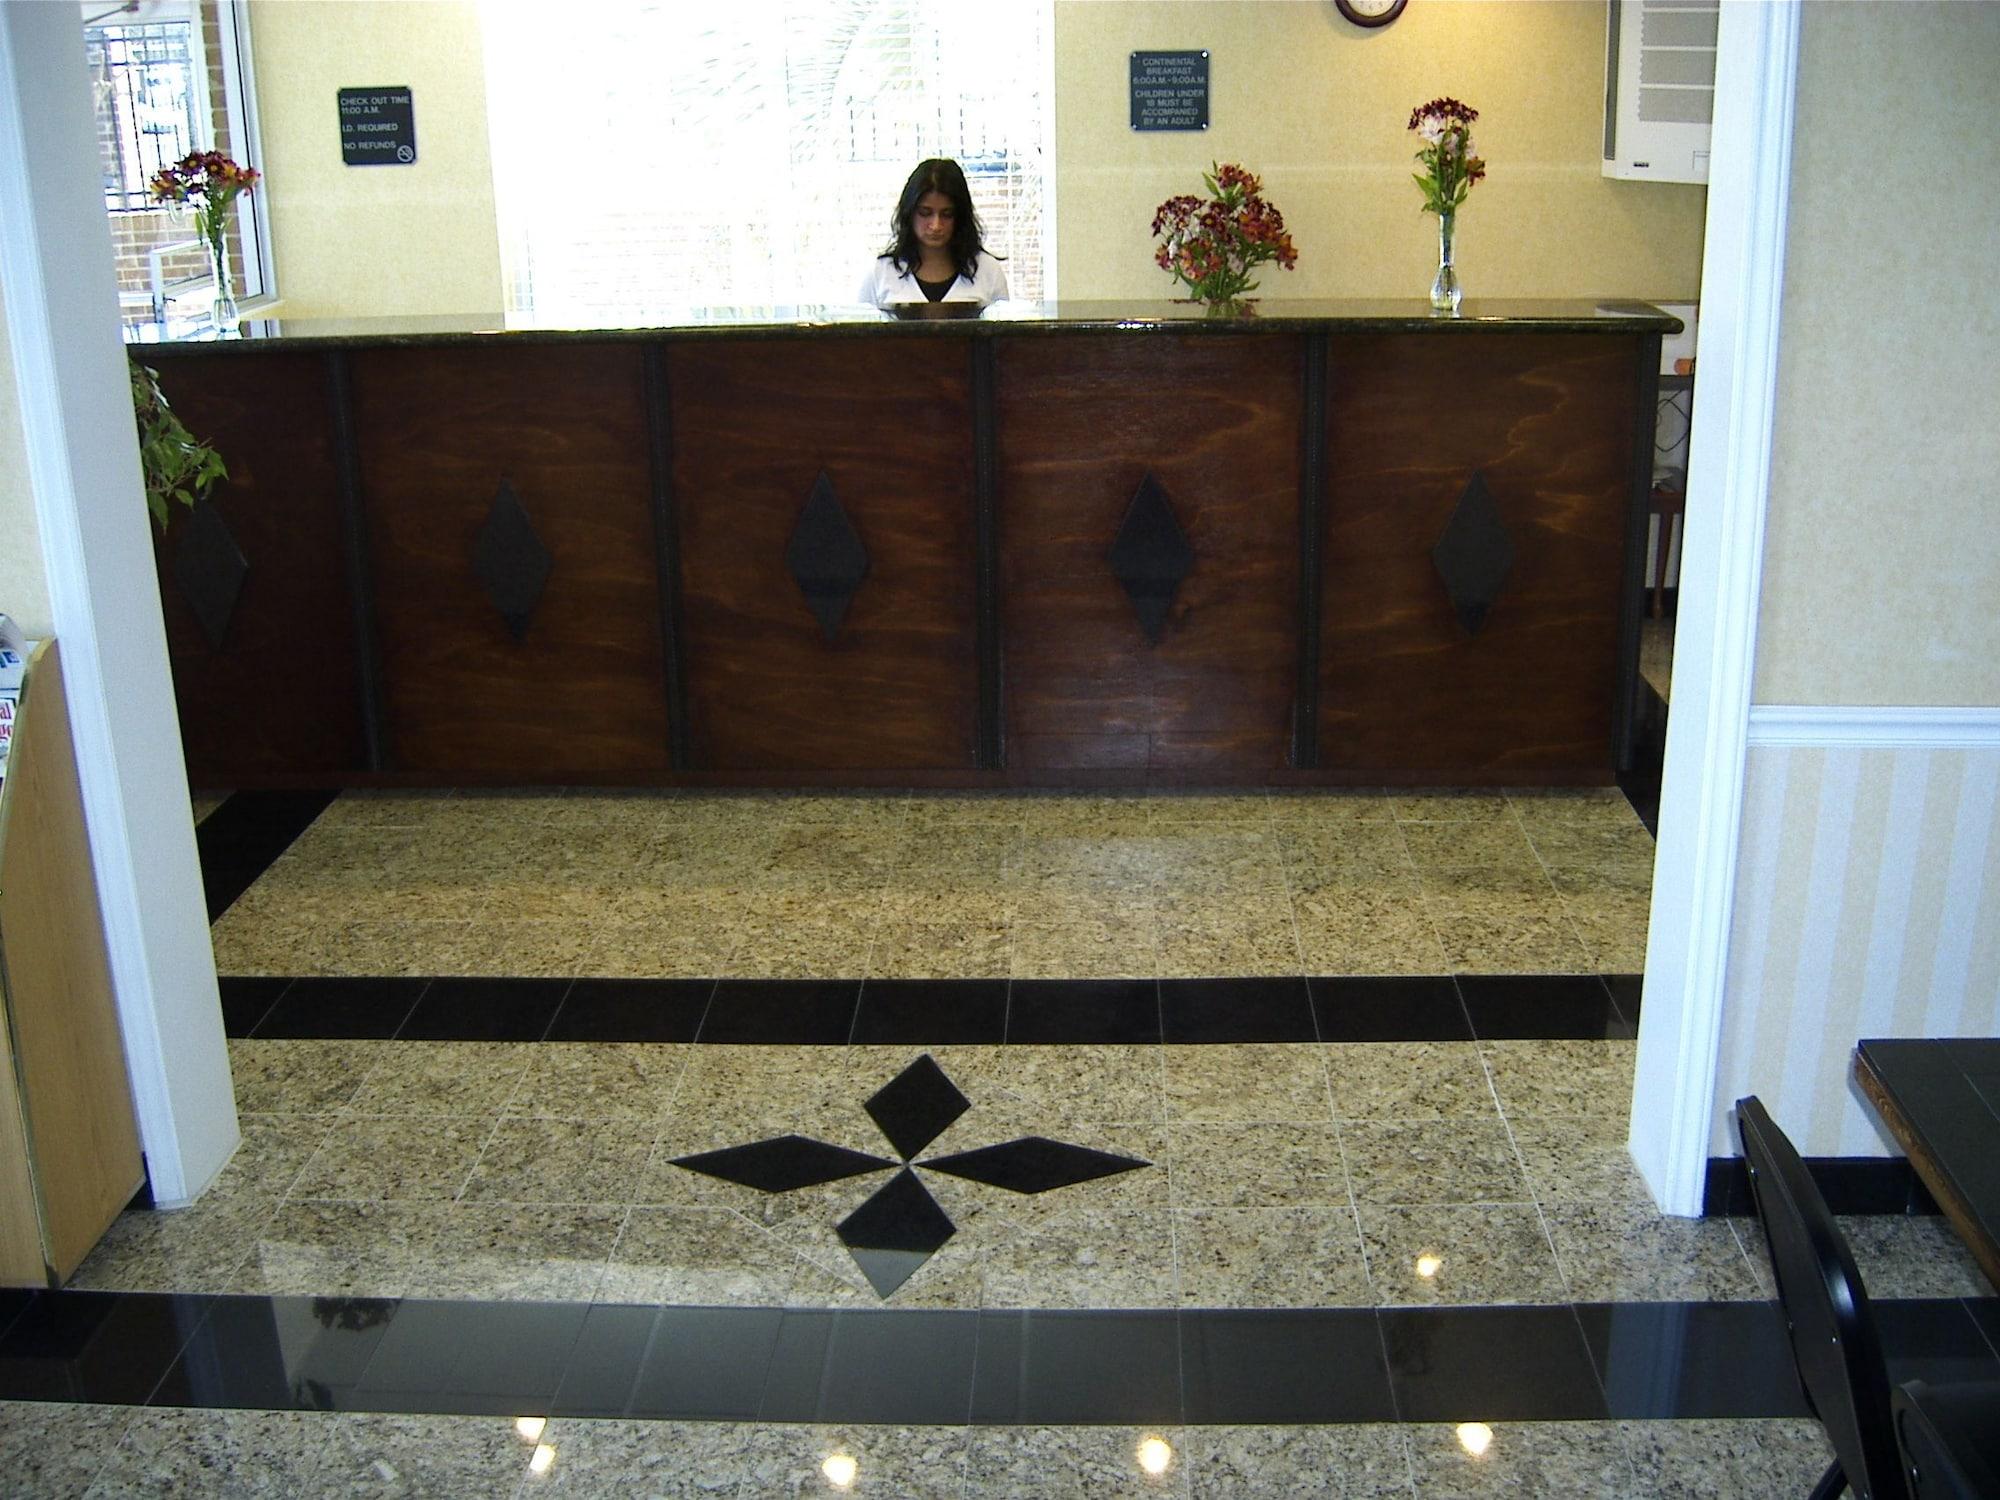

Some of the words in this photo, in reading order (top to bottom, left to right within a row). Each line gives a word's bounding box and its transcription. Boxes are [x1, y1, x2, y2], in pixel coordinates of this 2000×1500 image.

[1142, 58, 1196, 66] CONTINENTAL
[1146, 67, 1191, 75] BREAKFAST
[1135, 90, 1175, 98] CHILDREN
[1177, 89, 1205, 97] UNDER
[340, 97, 369, 105] CHECK
[371, 97, 388, 105] OUT
[391, 96, 410, 104] TIME
[1157, 99, 1179, 107] MUST
[1182, 98, 1193, 106] BE
[1141, 108, 1198, 116] ACCOMPANIED
[1143, 117, 1154, 125] BY
[1157, 117, 1169, 125] AN
[1171, 117, 1195, 125] ADULT
[357, 123, 398, 131] REQUIRED
[344, 142, 356, 150] NO
[358, 141, 396, 149] REFUNDS
